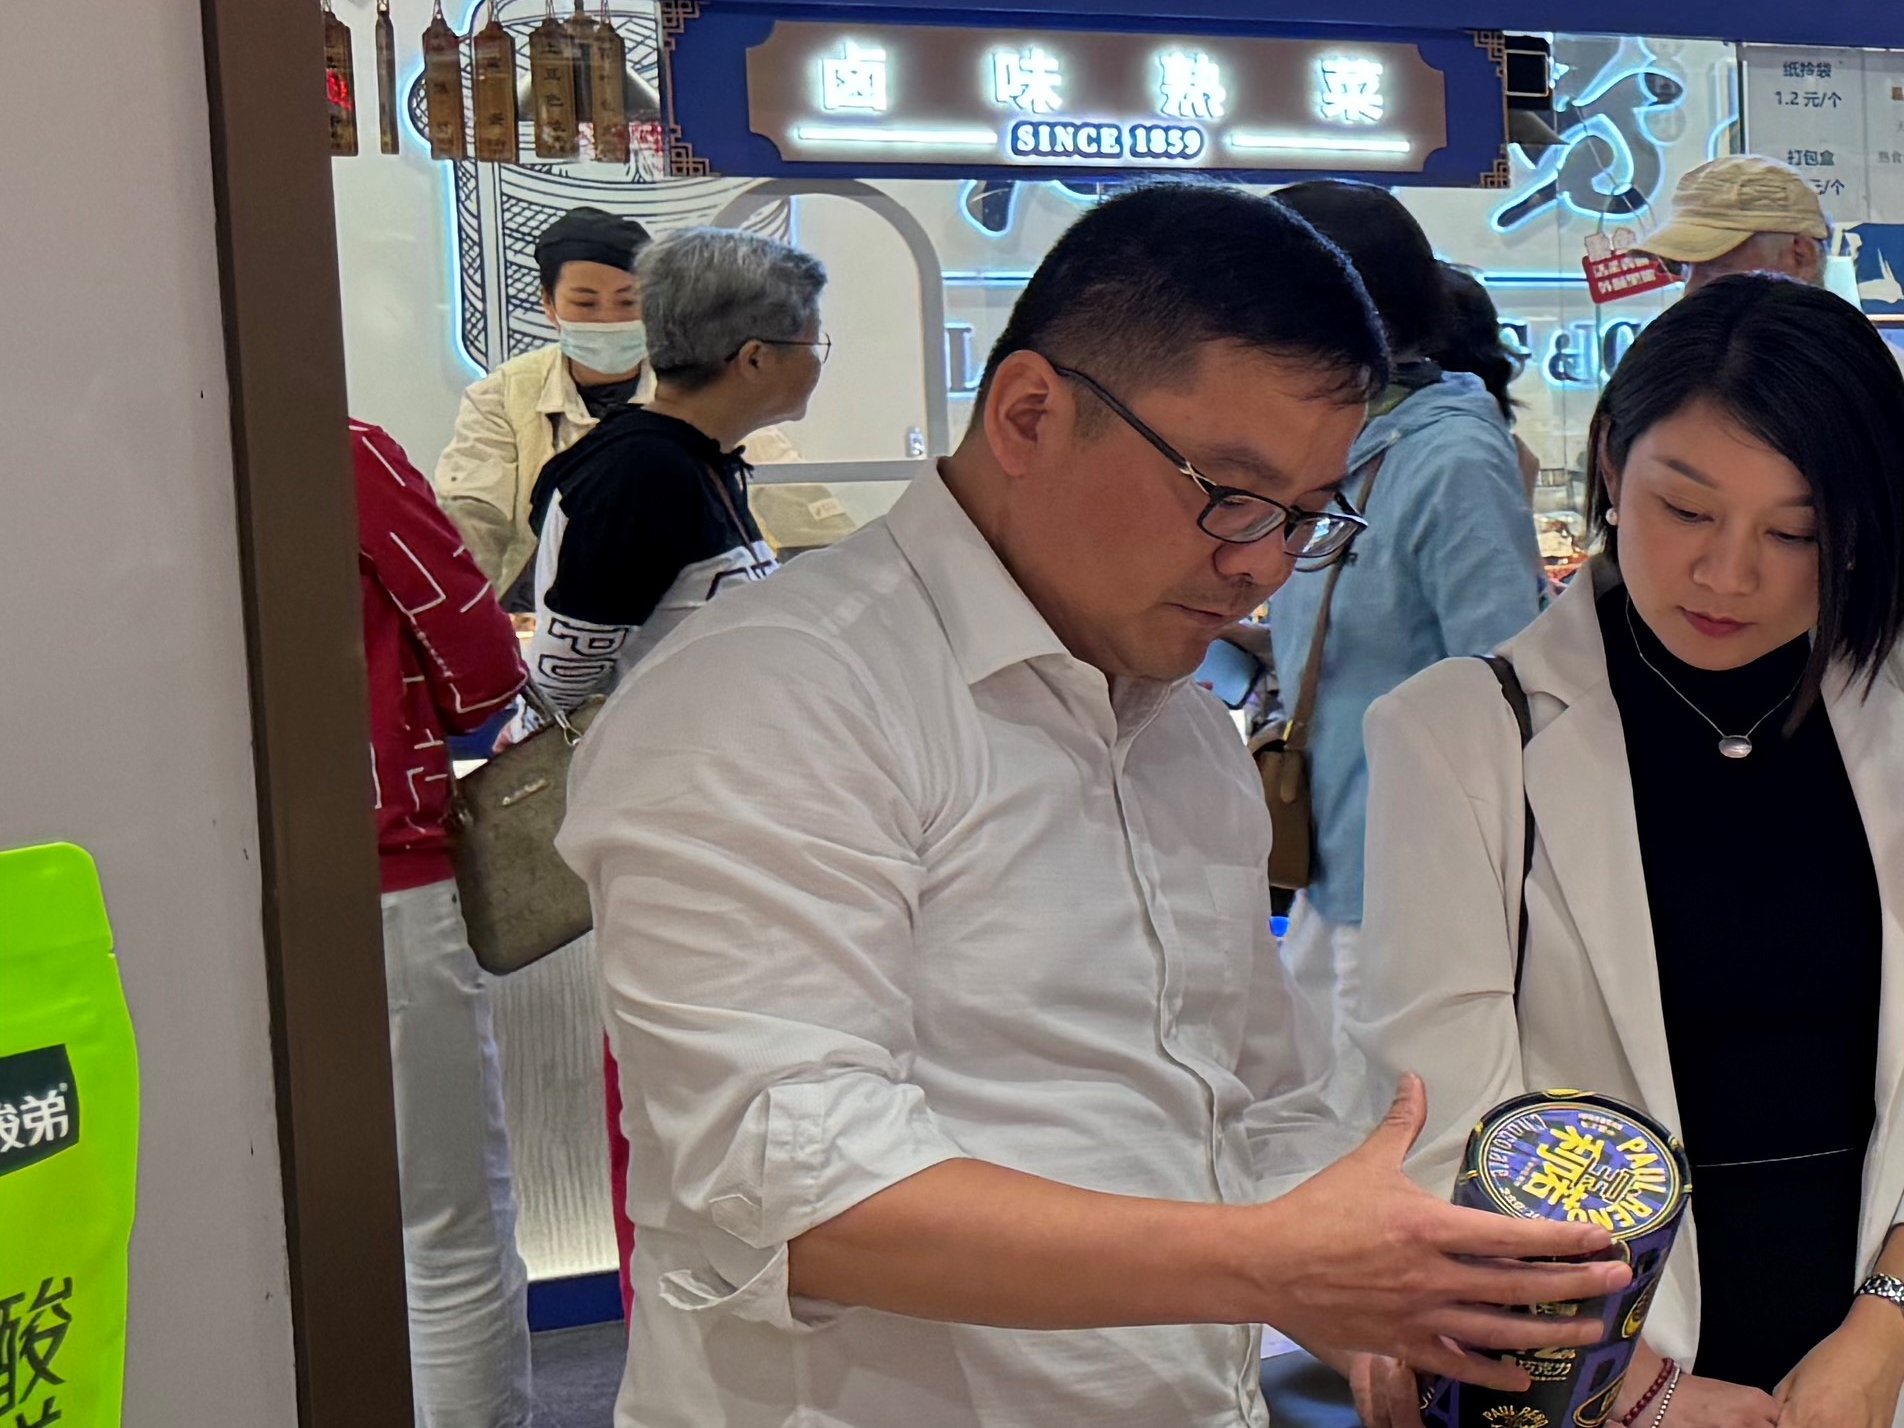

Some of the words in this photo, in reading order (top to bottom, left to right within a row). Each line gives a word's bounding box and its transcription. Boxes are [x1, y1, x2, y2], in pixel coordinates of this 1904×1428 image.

[819, 42, 1385, 122] 卤味熟菜
[1774, 91, 1799, 106] 1.2
[1803, 91, 1842, 108] 元/个
[1014, 124, 1120, 156] SINCE
[1129, 125, 1203, 158] 1859
[1787, 149, 1835, 166] 打包盒
